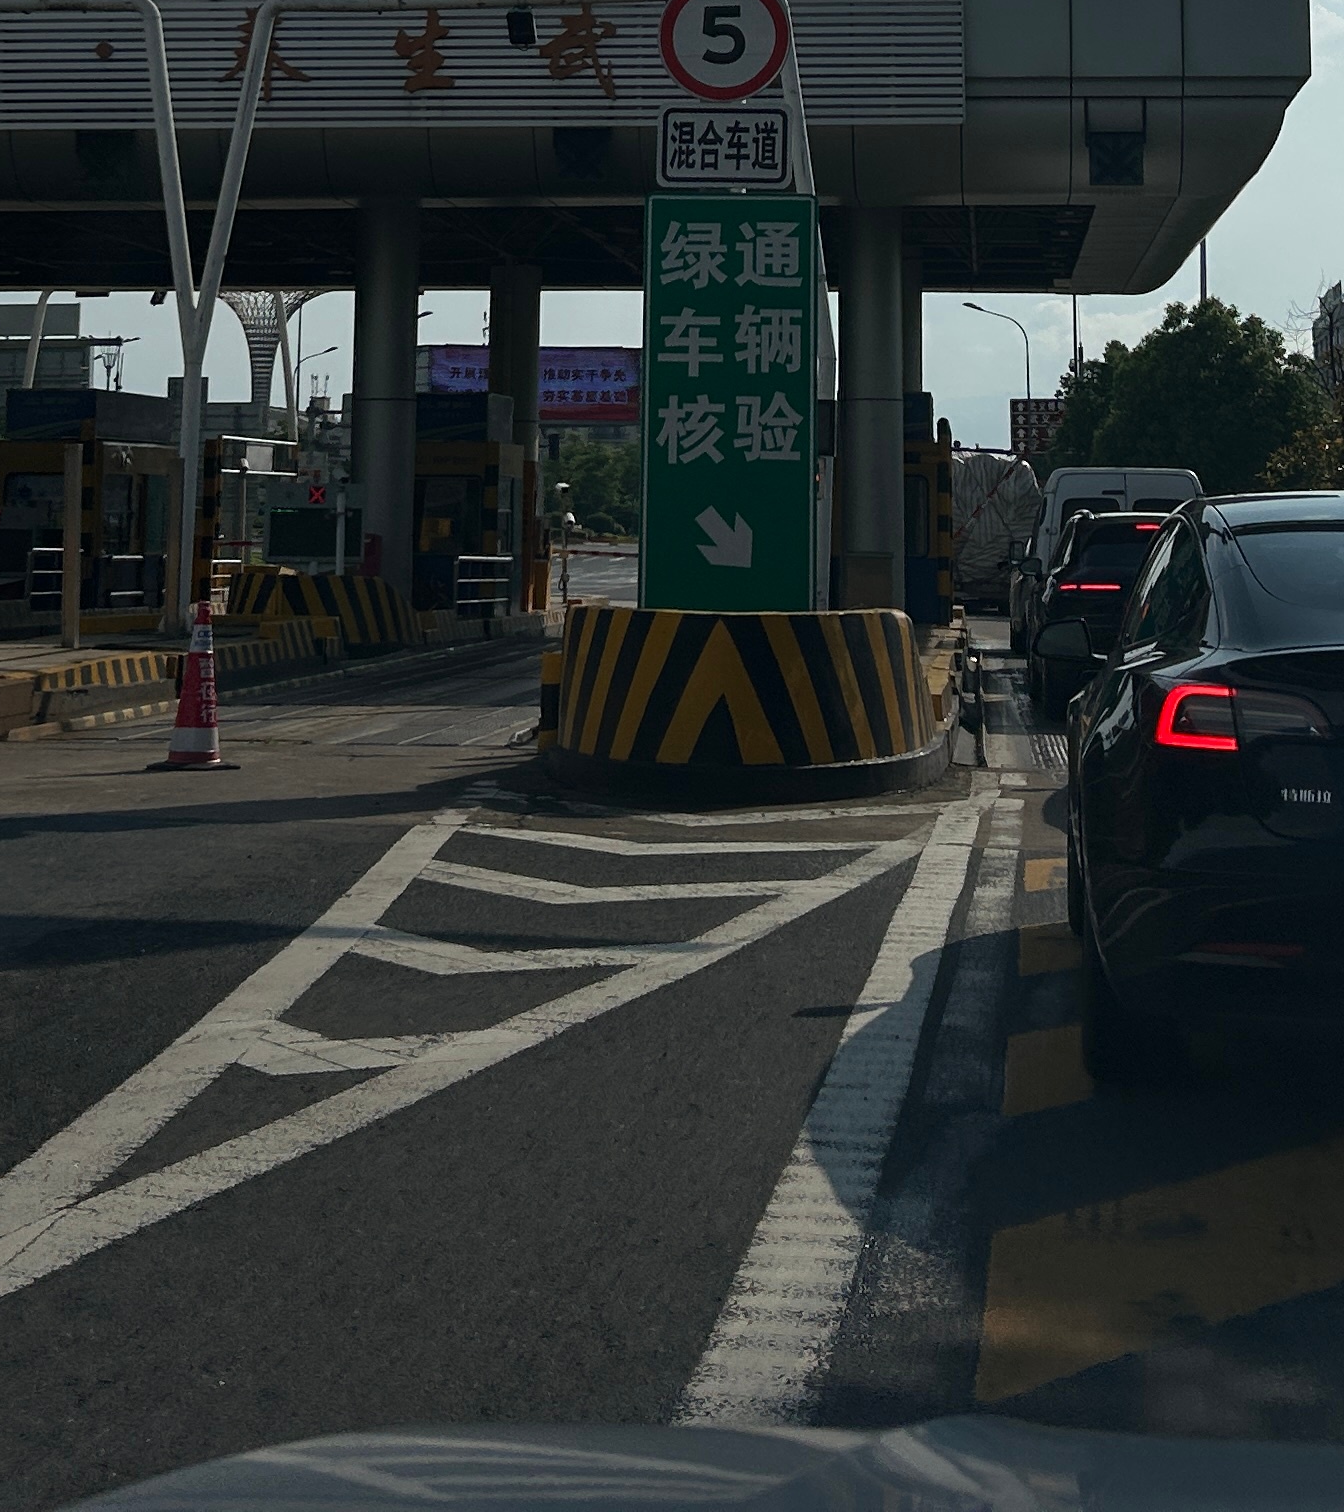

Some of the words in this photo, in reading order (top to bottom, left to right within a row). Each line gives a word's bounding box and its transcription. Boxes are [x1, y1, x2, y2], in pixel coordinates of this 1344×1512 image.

[702, 5, 746, 64] 5
[669, 119, 779, 172] 混合车道
[659, 221, 804, 289] 绿通
[657, 305, 803, 377] 车辆
[657, 392, 803, 465] 核验
